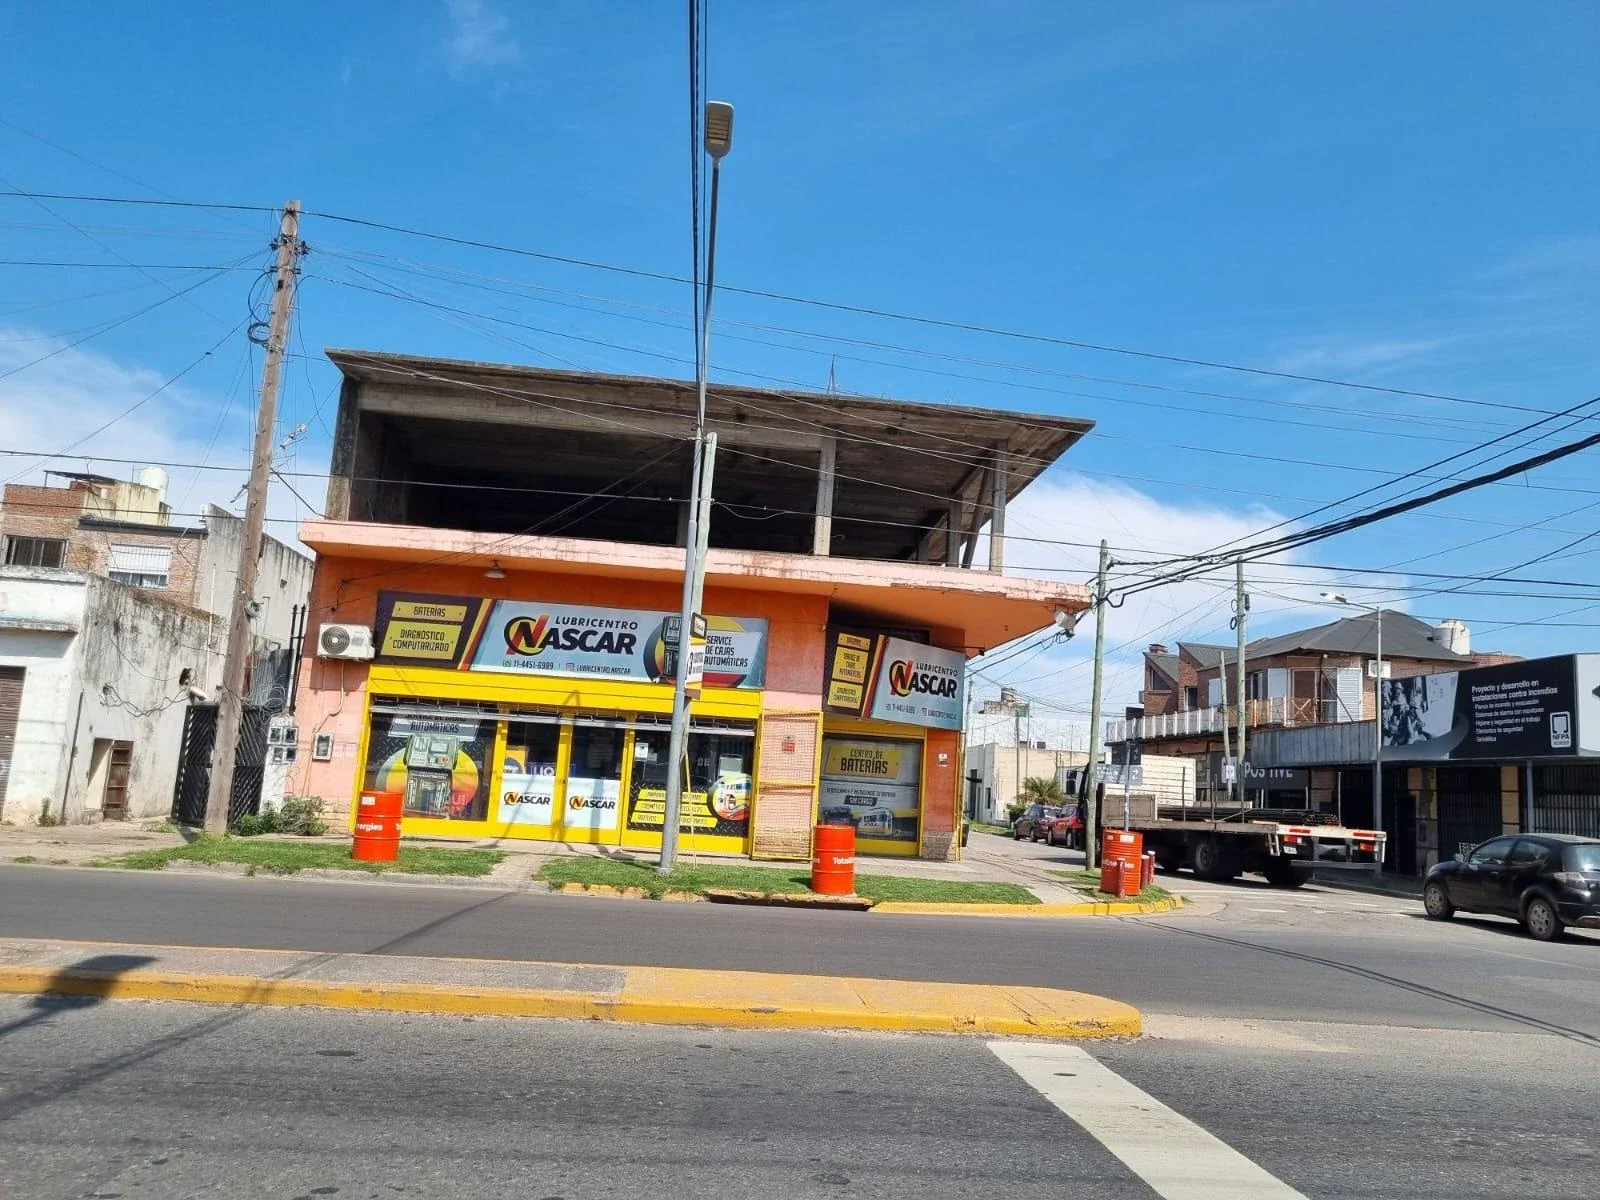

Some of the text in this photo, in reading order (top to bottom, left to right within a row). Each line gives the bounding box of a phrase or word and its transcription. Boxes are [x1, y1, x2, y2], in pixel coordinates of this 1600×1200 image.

[414, 606, 446, 617] BATERÍAS
[556, 616, 638, 630] LUBRICENTRO
[505, 615, 636, 656] NASCAR
[707, 635, 732, 645] SERVICE
[392, 640, 449, 652] COMPUTARIZADO
[705, 646, 735, 655] DE CAJAS
[916, 662, 958, 676] LUBRICENTRO
[889, 660, 958, 698] NASCAR
[1472, 685, 1495, 694] Proyecto
[1501, 681, 1530, 690] desarrollo
[1509, 690, 1527, 698] contra
[1528, 686, 1558, 696] incendios
[841, 756, 888, 774] BATERÍAS
[504, 792, 550, 806] NASCAR
[570, 795, 615, 810] NASCAR
